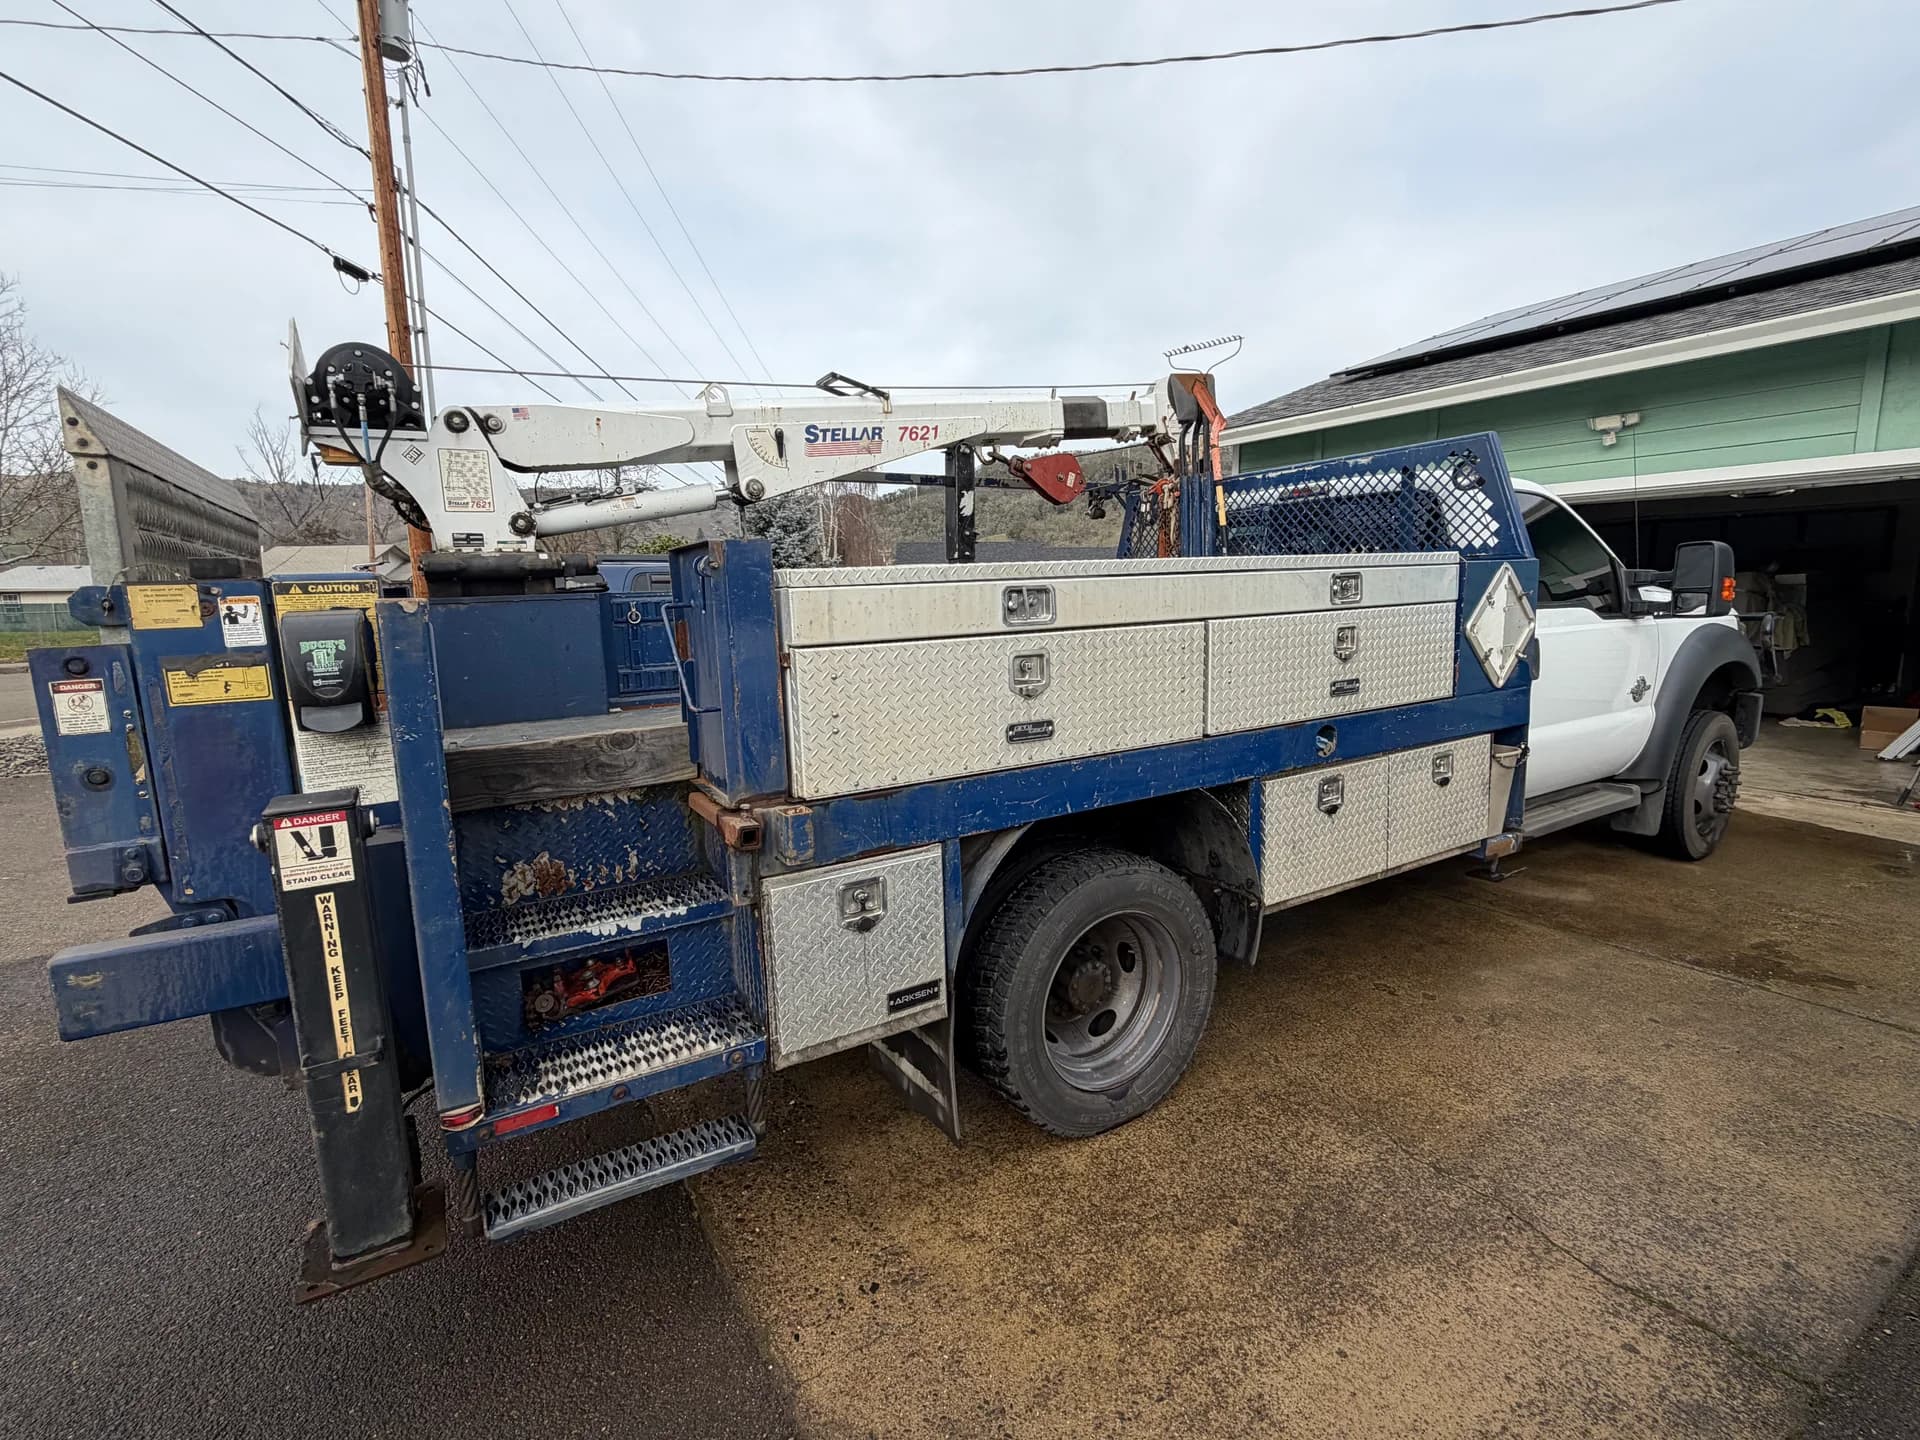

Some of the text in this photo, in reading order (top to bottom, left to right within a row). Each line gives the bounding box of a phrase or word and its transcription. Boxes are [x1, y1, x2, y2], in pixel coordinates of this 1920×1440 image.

[804, 424, 939, 443] STELLAR 7621
[471, 500, 492, 508] 7621
[307, 584, 360, 593] CAUTION
[59, 683, 97, 691] DANGER
[293, 813, 340, 825] DANGER
[286, 870, 351, 886] STAND CLEAR
[317, 895, 358, 1093] WARNING KEEP FEET CEAR
[895, 987, 933, 1006] ARKSEN
